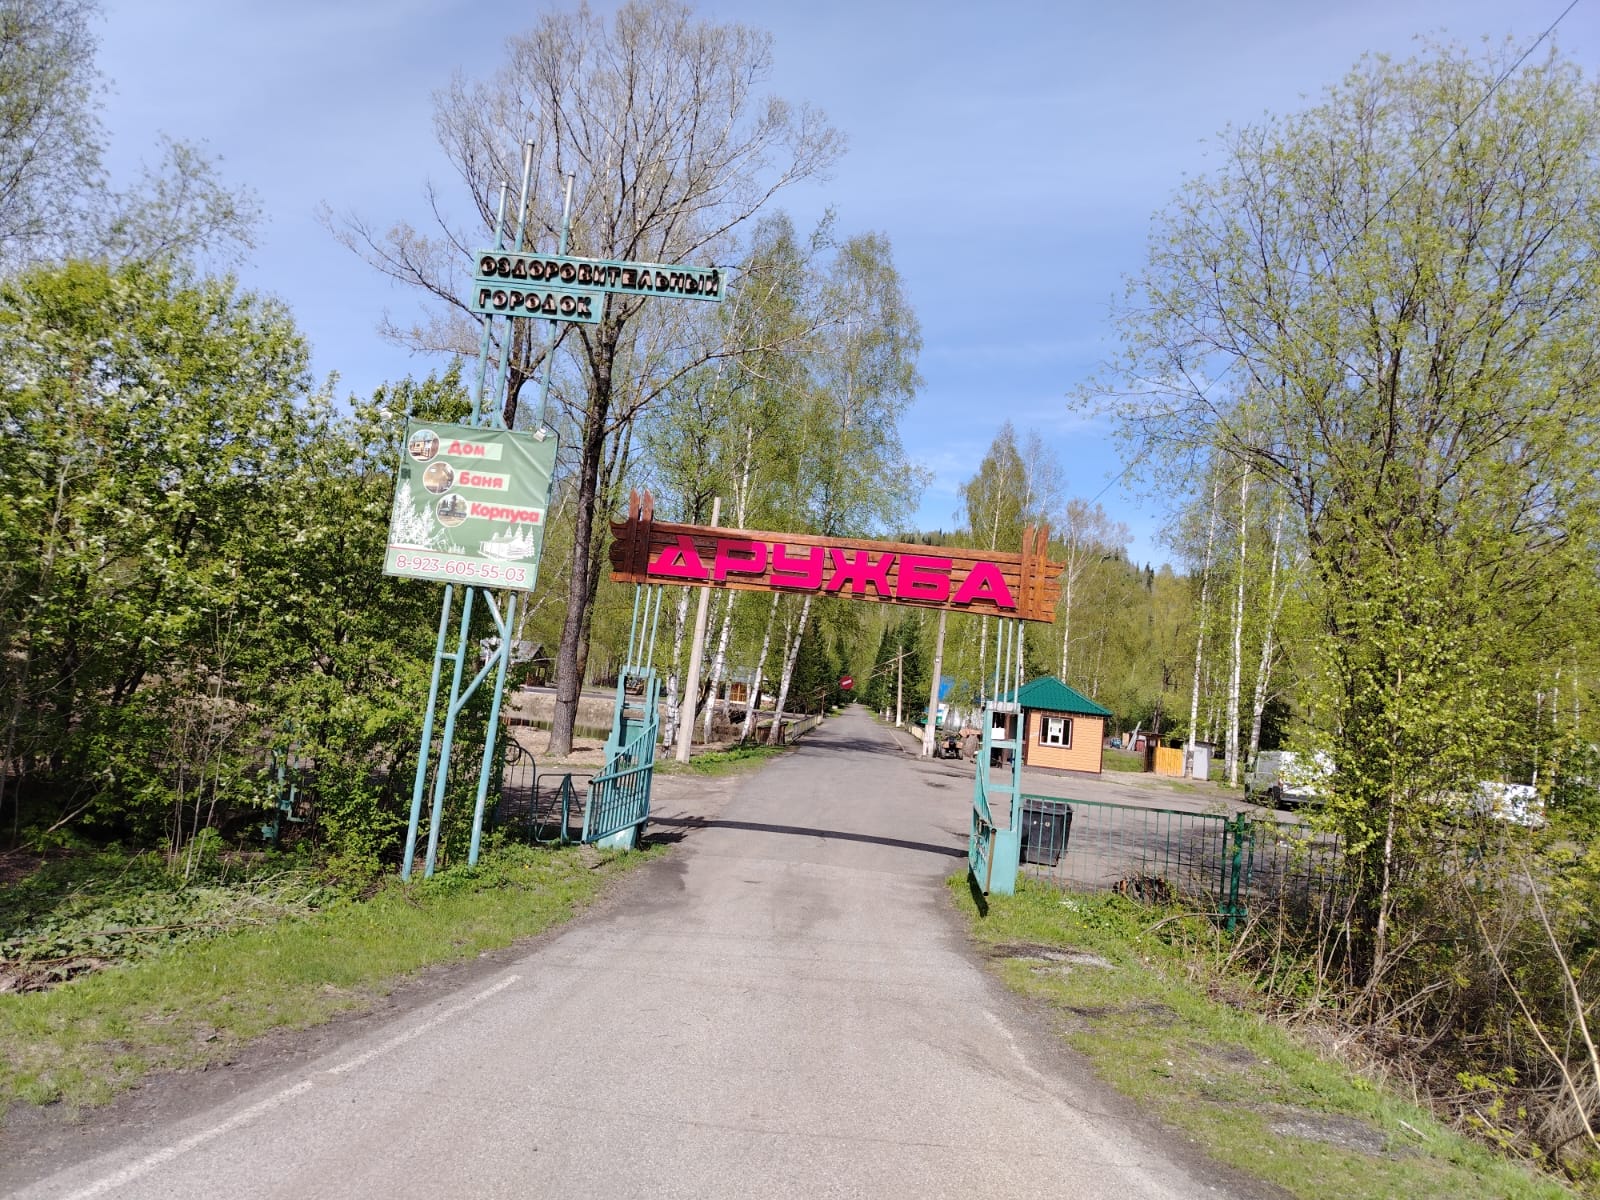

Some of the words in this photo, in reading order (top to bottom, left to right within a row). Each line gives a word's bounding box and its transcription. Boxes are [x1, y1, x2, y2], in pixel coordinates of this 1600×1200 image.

[480, 256, 720, 296] ОЗДОРОВИТЕЛЬНЫЙ
[478, 288, 592, 318] ГОРОДОК
[447, 440, 486, 456] Дом
[459, 471, 503, 489] Баня
[470, 502, 540, 523] Корпуса
[396, 555, 526, 582] 8-923-605-55-03
[647, 535, 1017, 609] ДРУЖБА
